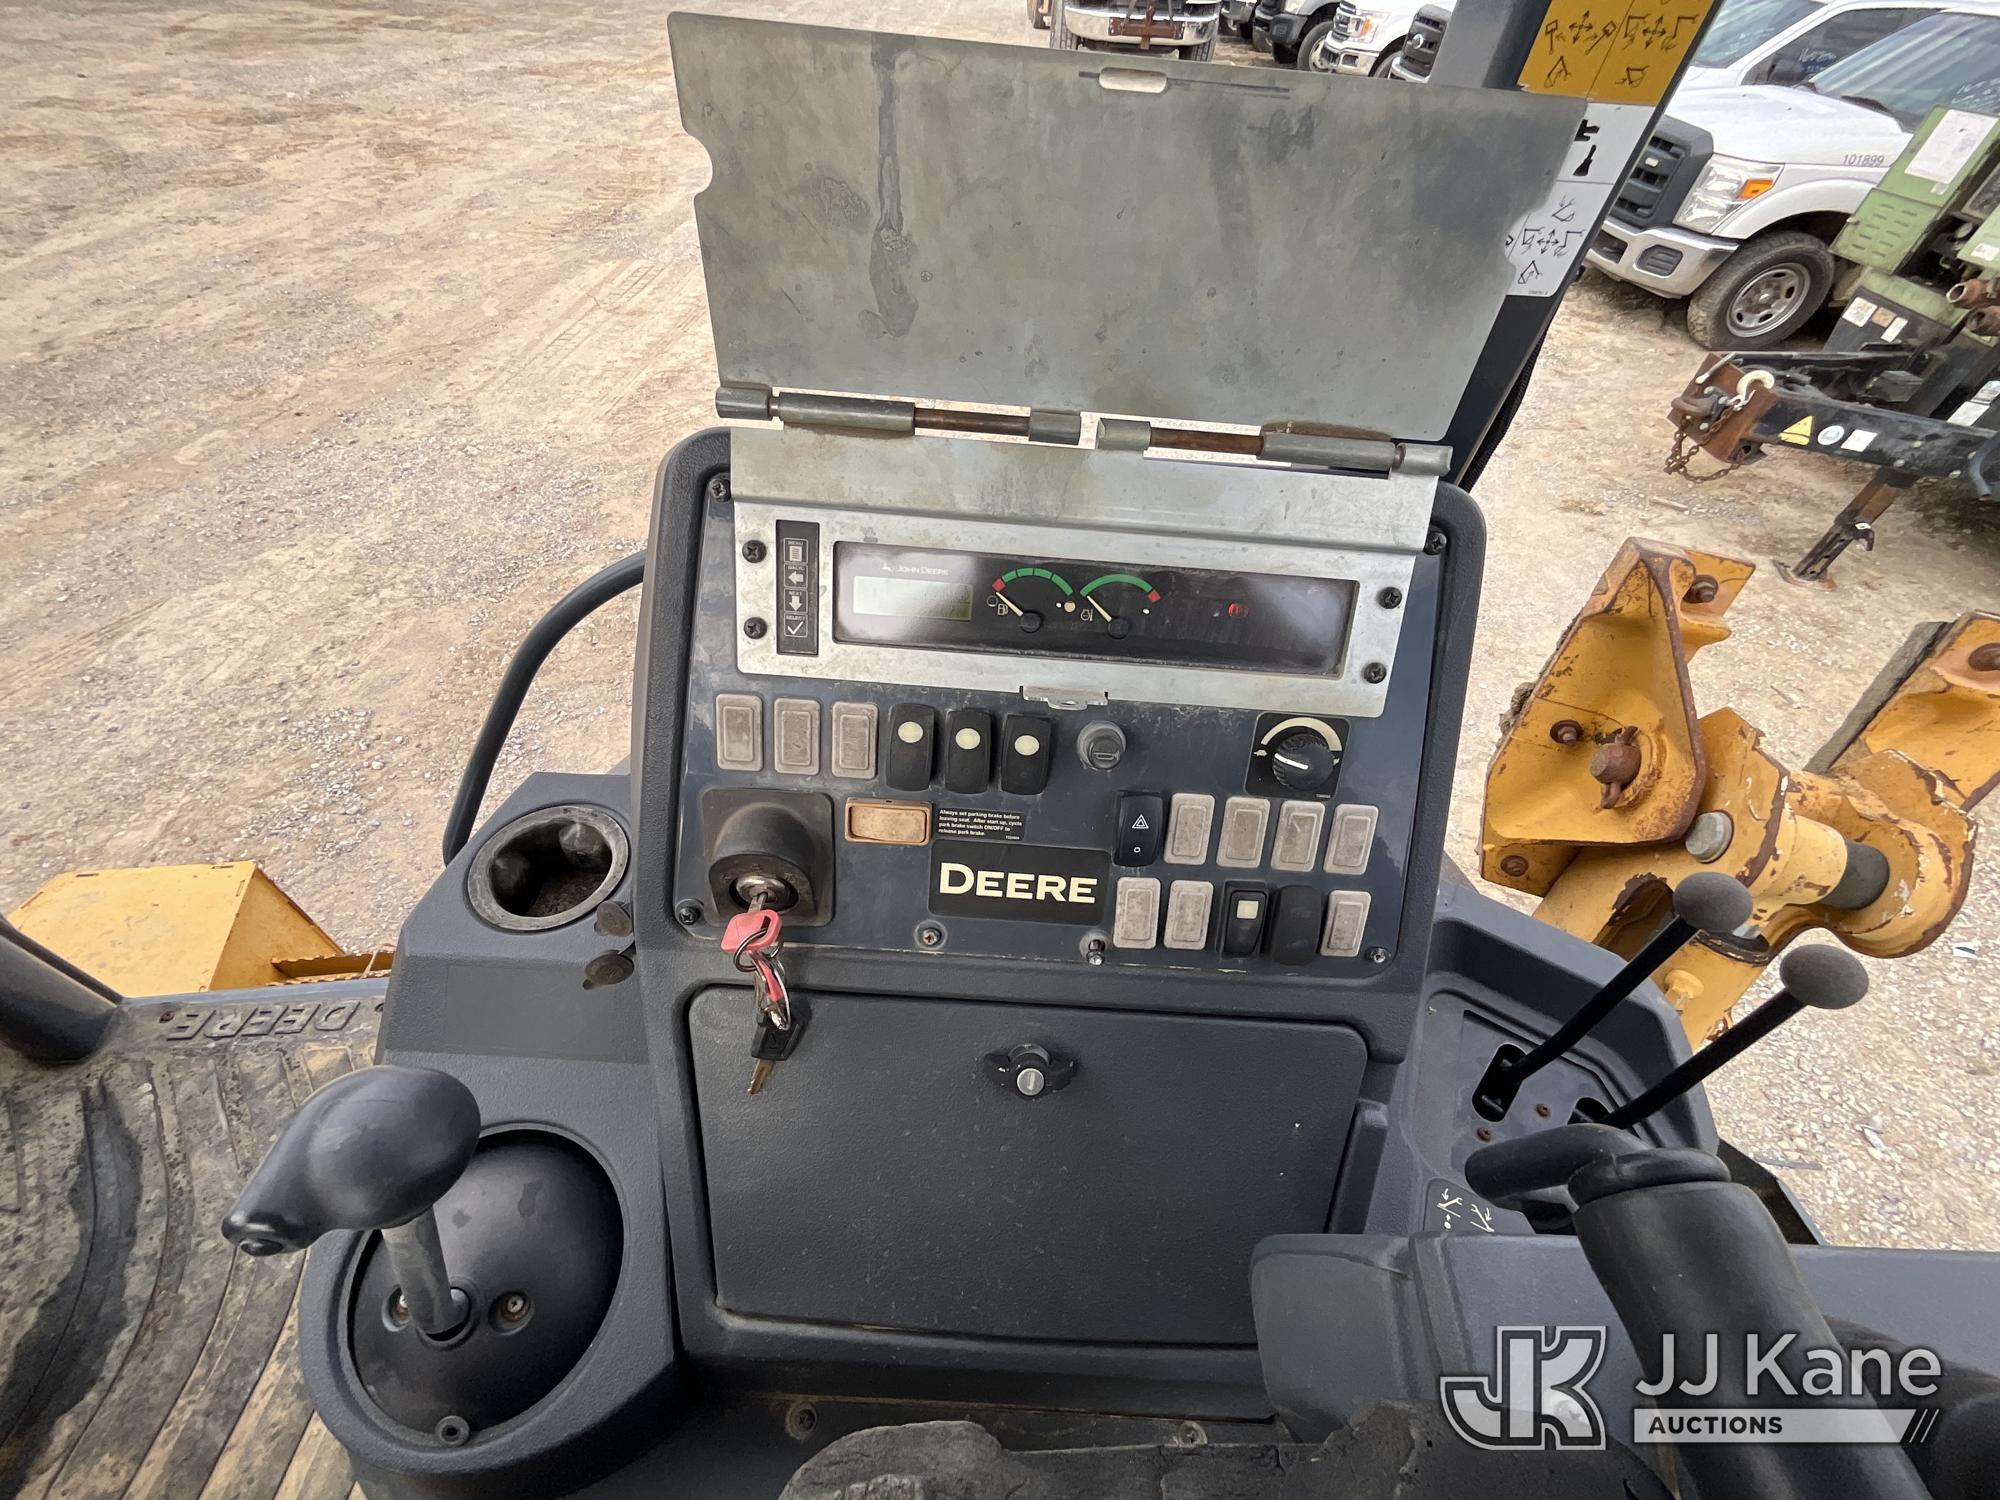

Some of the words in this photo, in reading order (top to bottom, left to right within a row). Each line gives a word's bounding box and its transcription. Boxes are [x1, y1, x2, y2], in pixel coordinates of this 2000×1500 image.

[1842, 153, 1885, 168] 101899
[896, 564, 920, 573] JOHN
[920, 566, 950, 576] DEERE
[939, 862, 1098, 904] DEERE
